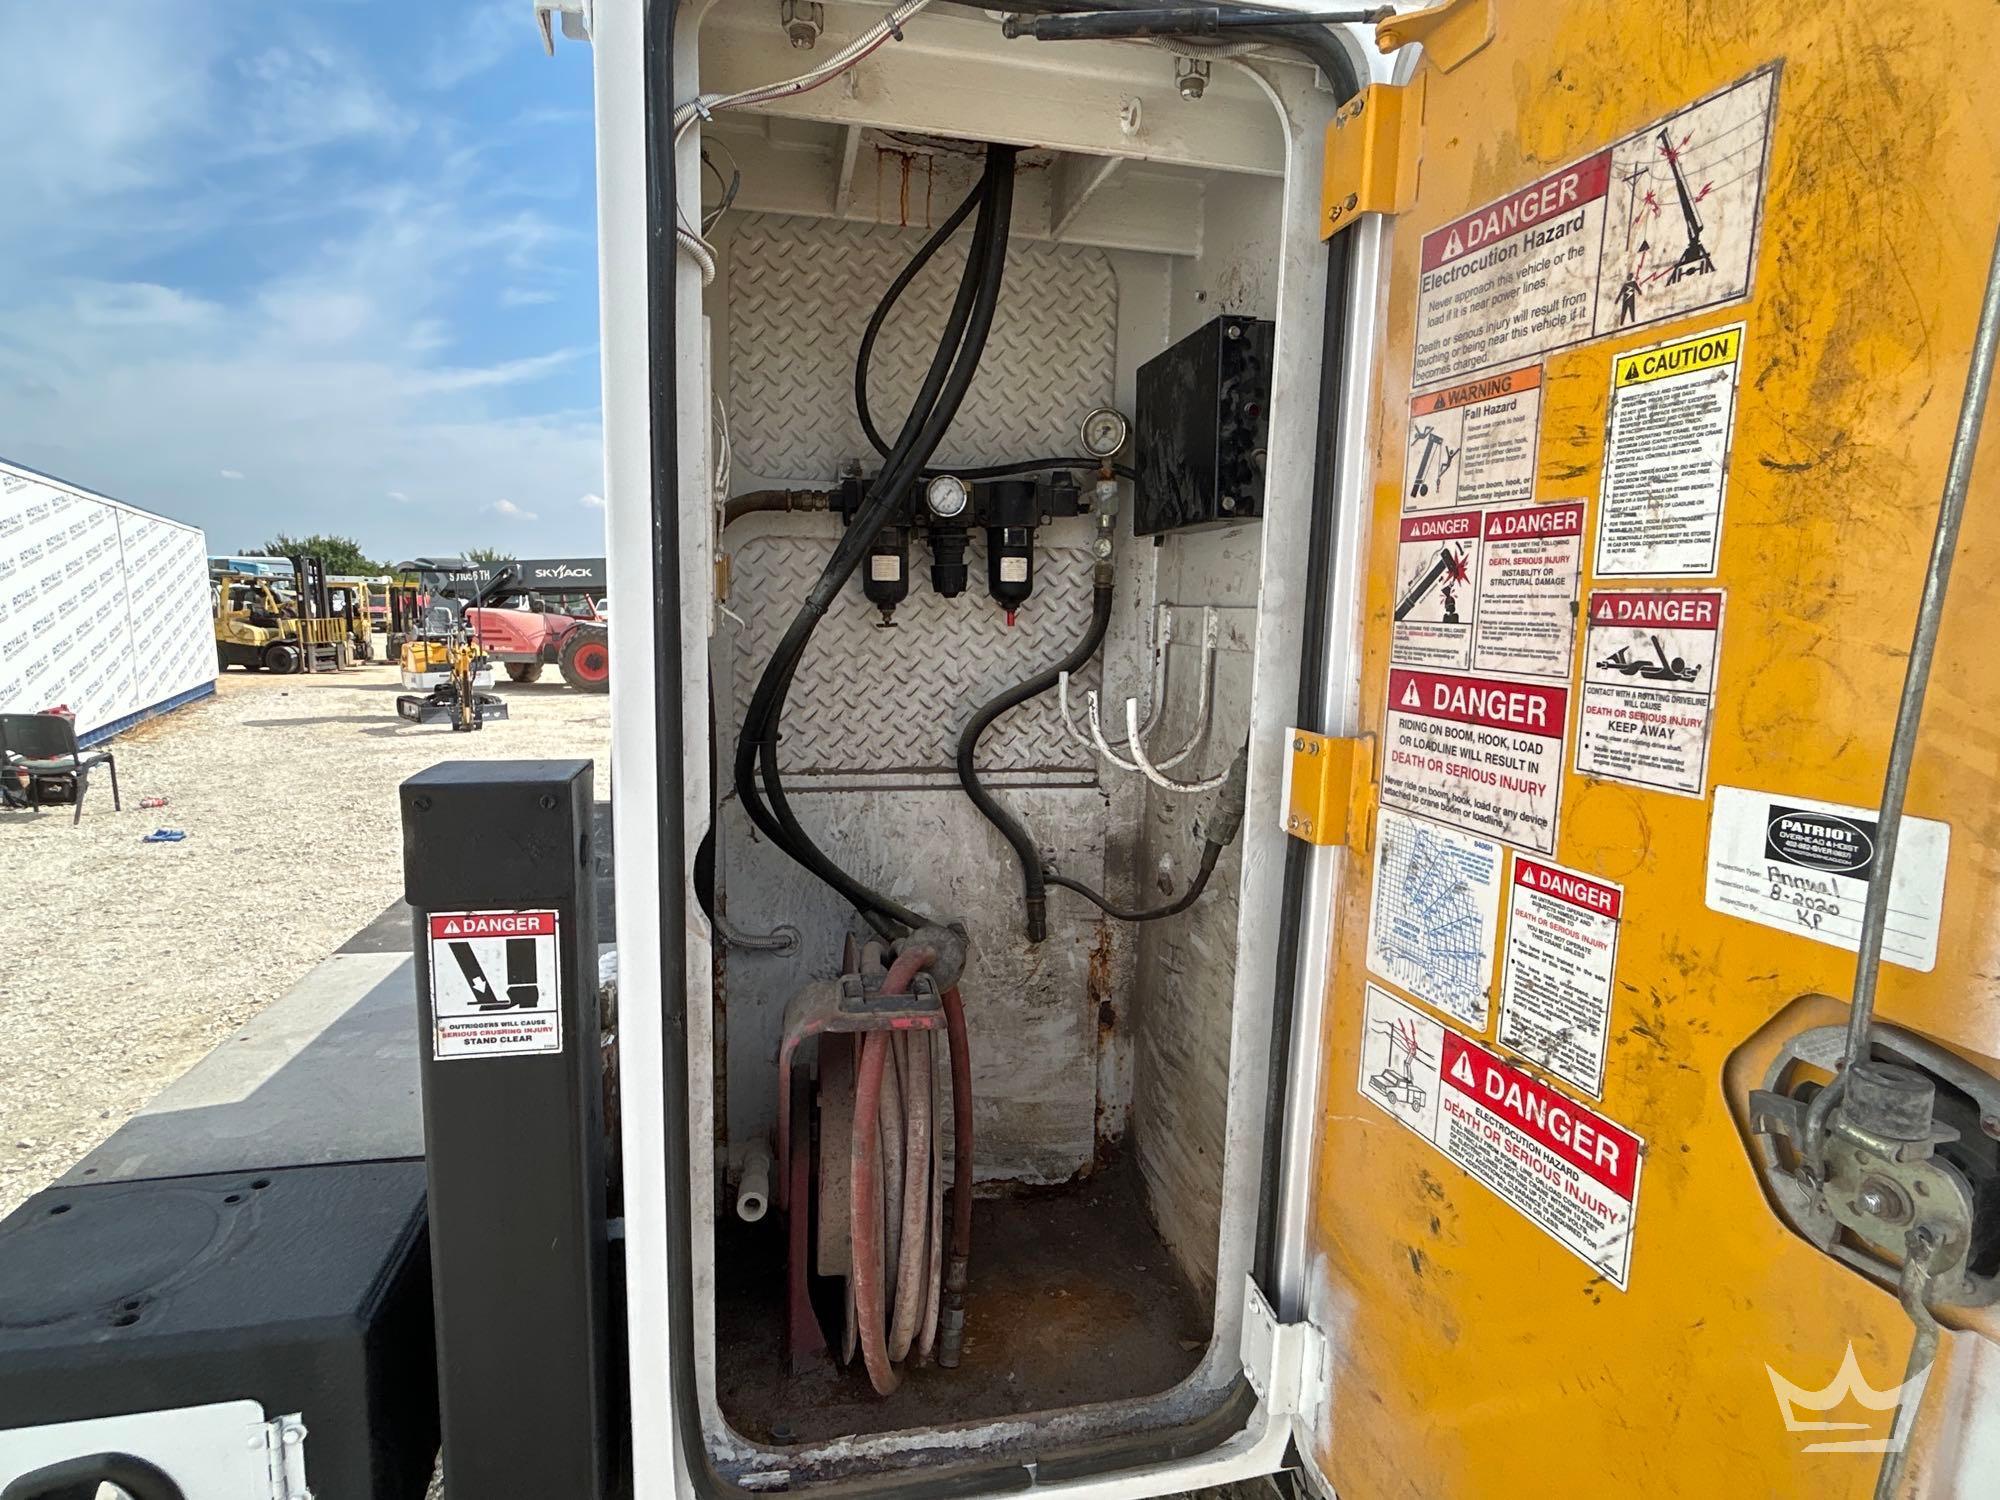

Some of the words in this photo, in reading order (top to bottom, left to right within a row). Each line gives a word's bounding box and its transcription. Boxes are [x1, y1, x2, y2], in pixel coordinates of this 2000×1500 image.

[1468, 173, 1579, 247] DANGER
[1421, 237, 1519, 294] Electrocution
[1522, 209, 1585, 253] Hazard
[1428, 293, 1452, 312] Never
[1454, 277, 1494, 305] approach
[1497, 269, 1513, 287] this
[1515, 255, 1551, 280] vehicle
[1553, 252, 1564, 265] or
[1566, 241, 1585, 261] the
[1427, 312, 1444, 328] load
[1446, 309, 1452, 321] if
[1452, 306, 1459, 319] it
[1460, 304, 1467, 316] is
[1469, 297, 1488, 313] near
[1491, 285, 1520, 308] power
[1522, 274, 1549, 295] lines.
[1417, 337, 1441, 355] Death
[1442, 336, 1451, 347] or
[1453, 323, 1483, 343] serious
[1485, 314, 1510, 336] injury
[1512, 307, 1528, 324] will
[1530, 297, 1559, 318] result
[1561, 288, 1587, 309] from
[1416, 349, 1449, 370] touching
[1451, 347, 1459, 358] or
[1461, 337, 1486, 357] being
[1488, 332, 1508, 347] near
[1510, 324, 1528, 339] this
[1531, 311, 1567, 334] vehicle
[1568, 308, 1577, 322] if
[1577, 305, 1586, 319] it
[1415, 363, 1451, 382] becomes
[1452, 351, 1490, 373] charged.
[1643, 339, 1729, 375] CAUTION
[1448, 376, 1512, 405] WARNING
[1465, 408, 1481, 420] Fall
[1484, 399, 1517, 415] Hazard
[1421, 518, 1469, 536] DANGER
[1505, 511, 1578, 534] DANGER
[479, 570, 490, 580] TH
[535, 564, 592, 579] SKYJACK
[1502, 568, 1541, 576] INSTABILITY
[1513, 556, 1542, 564] SERIOUS
[1544, 555, 1569, 563] INJURY
[1617, 600, 1713, 622] DANGER
[1433, 683, 1548, 727] DANGER
[1586, 687, 1614, 696] CONTACT
[1615, 689, 1630, 698] WITH
[1637, 692, 1669, 702] ROTATING
[1671, 695, 1706, 706] DRIVELINE
[1623, 699, 1638, 708] WILL
[1639, 701, 1661, 710] CAUSE
[1586, 705, 1612, 716] DEATH
[1613, 709, 1626, 718] OR
[1628, 711, 1666, 723] SERIOUS
[1669, 716, 1702, 728] INJURY
[1608, 720, 1637, 734] KEEP
[1640, 724, 1675, 740] AWAY
[1398, 718, 1427, 732] RIDING
[1429, 723, 1442, 735] ON
[1444, 726, 1475, 744] BOOM,
[1477, 732, 1510, 750] HOOK,
[1512, 738, 1543, 755] LOAD
[1399, 734, 1411, 746] OR
[1413, 737, 1457, 756] LOADLINE
[1459, 747, 1482, 762] WILL
[1484, 752, 1525, 771] RESULT
[1527, 760, 1539, 774] IN
[1391, 750, 1424, 768] DEATH
[1427, 758, 1443, 773] OR
[1445, 762, 1496, 786] SERIOUS
[1499, 774, 1546, 798] INJURY
[1383, 786, 1410, 801] attached
[1411, 794, 1419, 803] to
[1420, 798, 1439, 809] crane
[1440, 802, 1461, 815] boom
[1463, 810, 1470, 818] or
[1384, 774, 1403, 787] Never
[1404, 780, 1417, 791] ride
[1418, 785, 1426, 794] on
[1451, 792, 1472, 807] hook,
[1474, 798, 1490, 811] load
[1492, 805, 1501, 814] or
[1502, 808, 1517, 821] any
[1519, 810, 1548, 827] device
[1779, 830, 1824, 846] OVERHEAD
[1832, 841, 1858, 852] HOIST
[1780, 818, 1852, 842] PATRIOT
[1539, 870, 1613, 912] DANGER
[1767, 865, 1841, 898] Annual
[1769, 883, 1841, 916] 8-2020
[463, 917, 540, 933] DANGER
[1515, 907, 1536, 922] DEATH
[1537, 916, 1547, 927] OR
[1549, 921, 1579, 940] SERIOUS
[1581, 934, 1608, 951] INJURY
[1797, 908, 1822, 931] KP
[1526, 923, 1536, 932] YOU
[1538, 928, 1552, 938] MUST
[1554, 934, 1565, 943] NOT
[1566, 939, 1591, 954] OPERATE
[1531, 932, 1543, 941] THIS
[1543, 937, 1562, 949] CRANE
[1563, 945, 1585, 959] UNLESS
[442, 1030, 478, 1038] SERIOUS
[449, 1021, 499, 1030] OUTRIGGERS
[464, 1037, 497, 1045] STAND
[500, 1035, 532, 1043] CLEAR
[1484, 1067, 1621, 1177] DANGER
[1475, 1106, 1541, 1157] ELECTROCUTION
[1542, 1151, 1579, 1183] HAZARD
[1444, 1097, 1480, 1132] DEATH
[1483, 1123, 1501, 1146] OR
[1503, 1137, 1561, 1187] SERIOUS
[1564, 1179, 1618, 1227] INJURY
[1451, 1117, 1463, 1130] WILL
[1463, 1126, 1483, 1144] RESULT
[1483, 1140, 1499, 1155] FROM
[1535, 1176, 1544, 1187] OR
[1545, 1183, 1561, 1199] LOAD
[1562, 1195, 1605, 1230] CONTACTING
